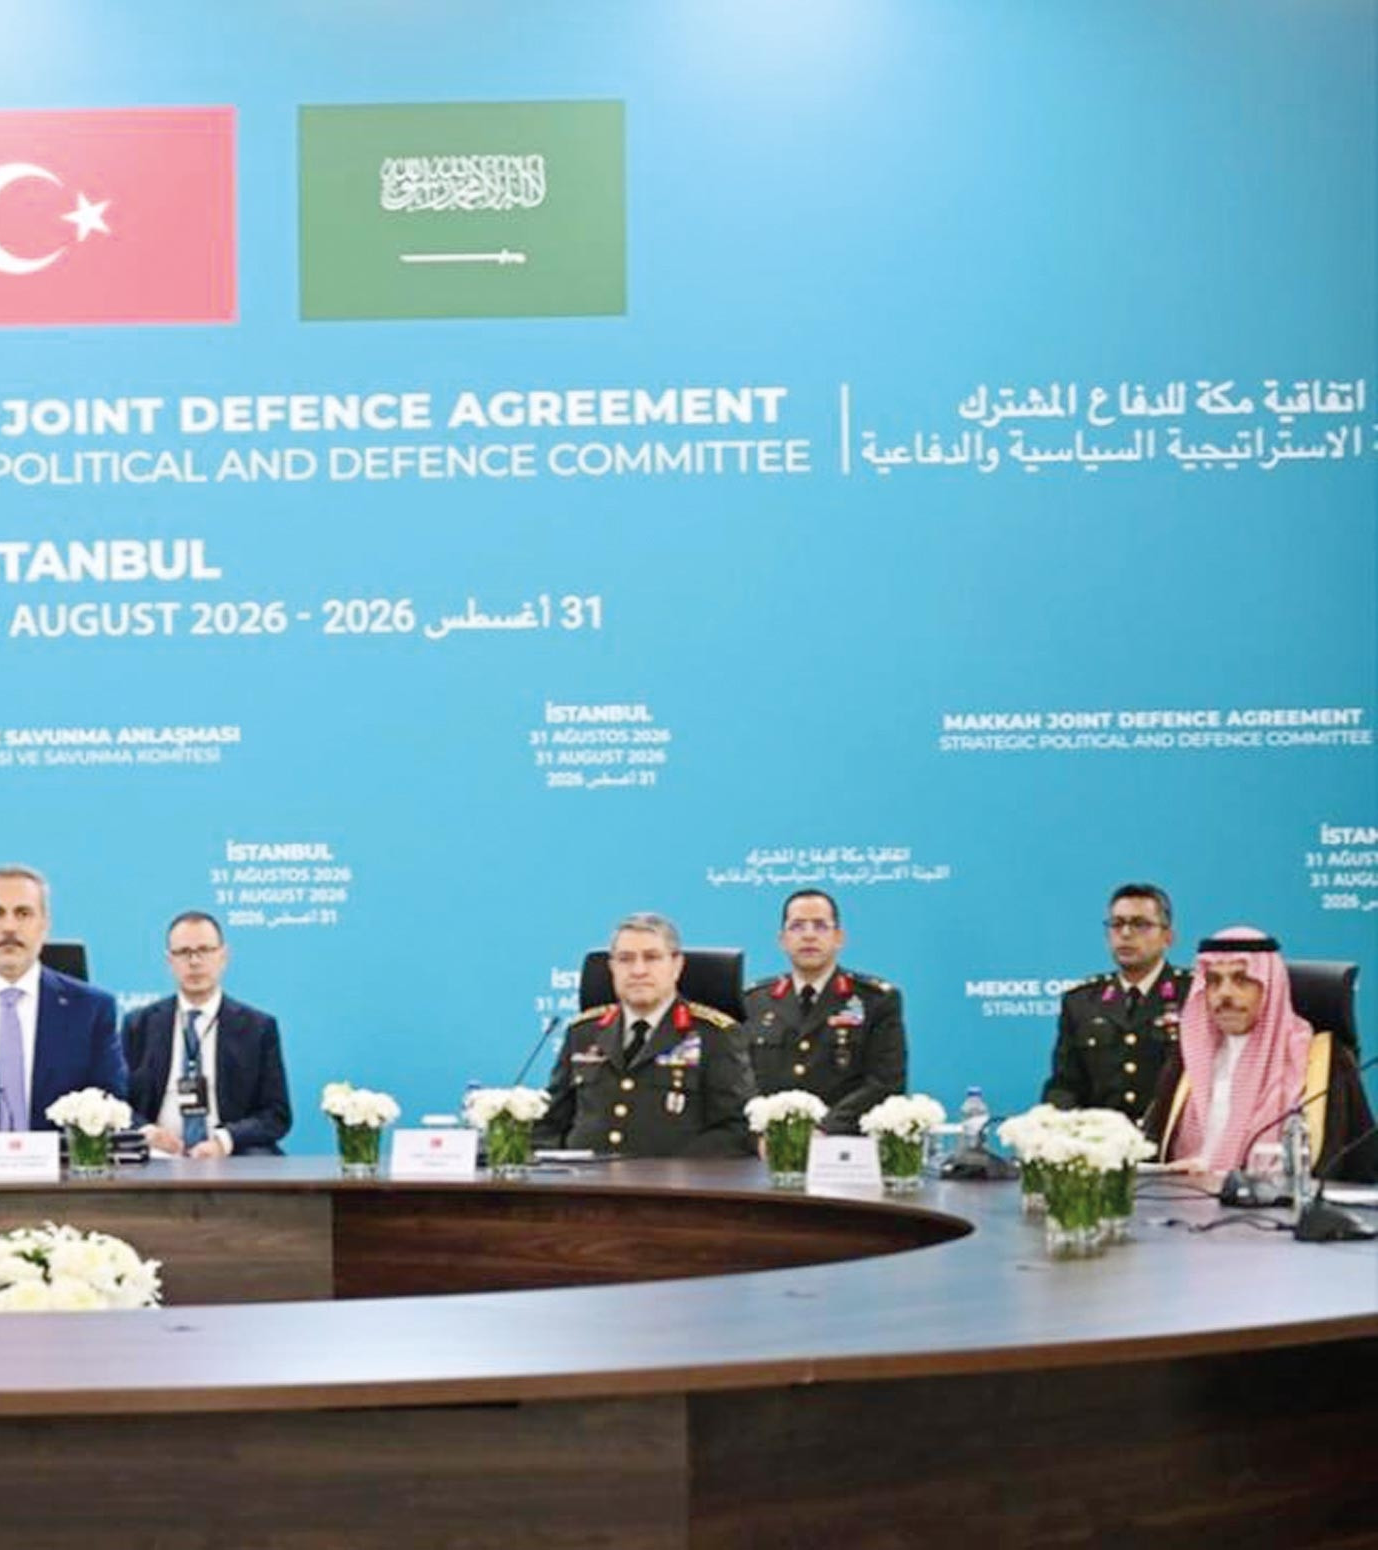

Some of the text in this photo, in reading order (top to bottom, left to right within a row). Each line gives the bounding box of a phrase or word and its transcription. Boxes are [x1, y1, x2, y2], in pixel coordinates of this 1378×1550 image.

[2, 398, 163, 435] JOINT
[180, 393, 431, 432] DEFENCE
[449, 387, 787, 427] AGREEMENT
[959, 379, 1365, 427] اتفاقية مكة للدفاع المشترك
[862, 427, 999, 474] والدفاعية
[1009, 430, 1155, 472] السياسية
[1167, 426, 1362, 470] الاستراتيجية
[216, 449, 317, 482] AND
[330, 445, 537, 481] DEFENCE
[548, 439, 811, 476] COMMITTEE
[9, 603, 180, 637] AUGUST
[190, 601, 288, 635] 2026
[322, 598, 416, 634] 2026
[424, 594, 551, 640] أغسطس
[560, 595, 602, 629] 31
[943, 708, 1363, 731] MAKKAH JOINT DEFENCE AGREEMENT
[4, 728, 113, 747] SAVUNMA
[530, 730, 547, 745] 31
[633, 727, 672, 743] 2026
[940, 729, 1373, 750] STRATEGIC POLITICAL AND DEFENCE COMMITTEE
[16, 750, 40, 765] VE
[43, 748, 134, 765] SAVUNMA
[536, 748, 667, 766] 31 AUGUST 2026
[547, 772, 585, 787] 2026
[638, 770, 656, 785] 31
[1306, 853, 1323, 867] 31
[210, 869, 228, 883] 31
[314, 866, 352, 882] 2026
[1310, 872, 1378, 887] 31 AUGU
[216, 887, 348, 904] 31 AUGUST 2026
[1322, 893, 1360, 909] 2026
[228, 910, 265, 925] 2026
[319, 909, 337, 925] 31
[966, 980, 1041, 997] MEKKE
